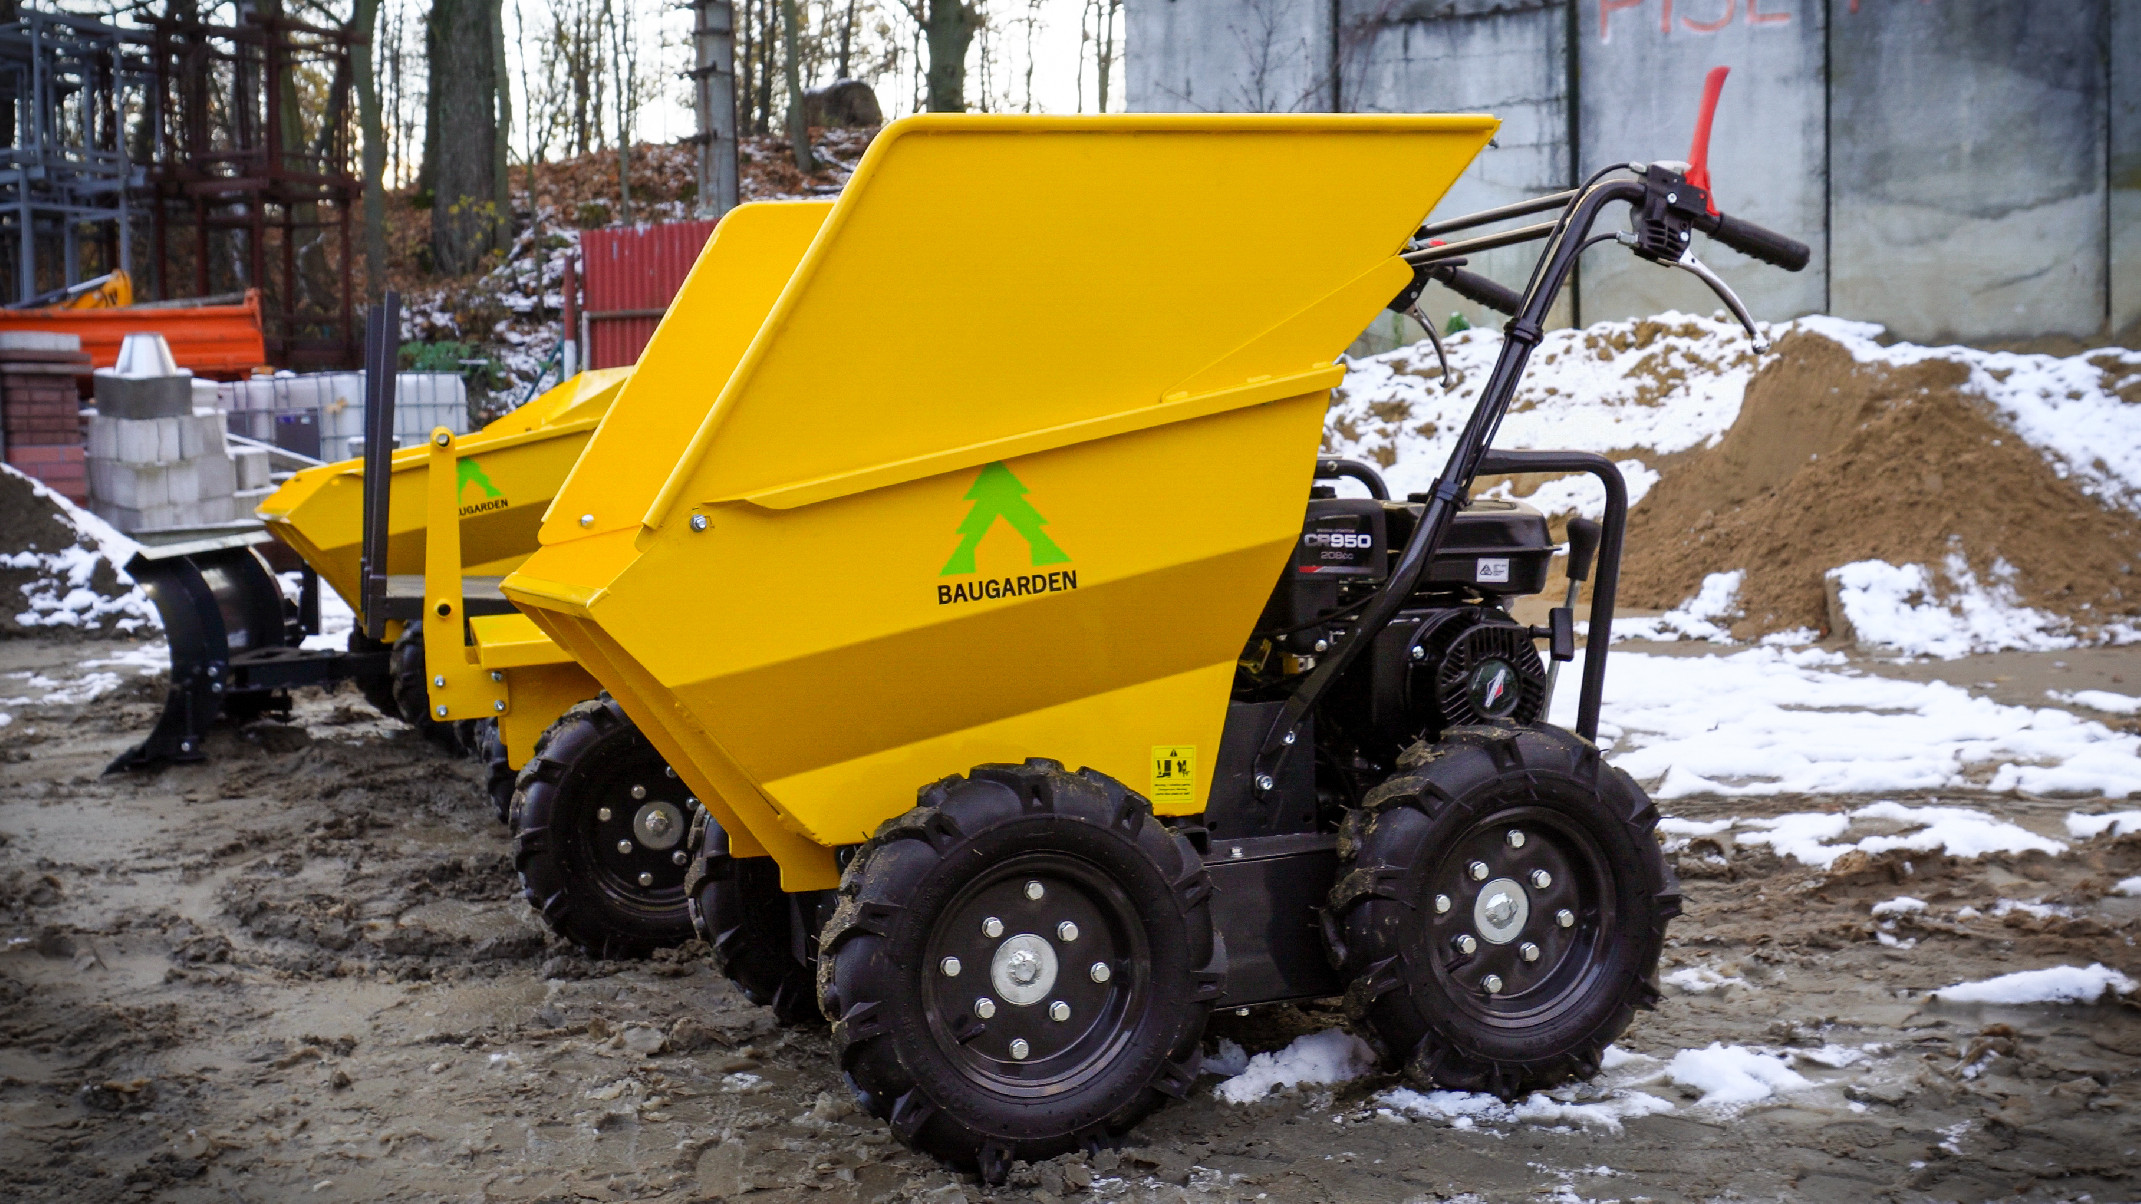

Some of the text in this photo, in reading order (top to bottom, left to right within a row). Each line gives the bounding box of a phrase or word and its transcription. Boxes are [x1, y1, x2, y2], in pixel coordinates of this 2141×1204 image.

[458, 499, 509, 516] UGARDEN
[1304, 533, 1372, 549] CR950
[937, 570, 1077, 605] BAUGARDEN
